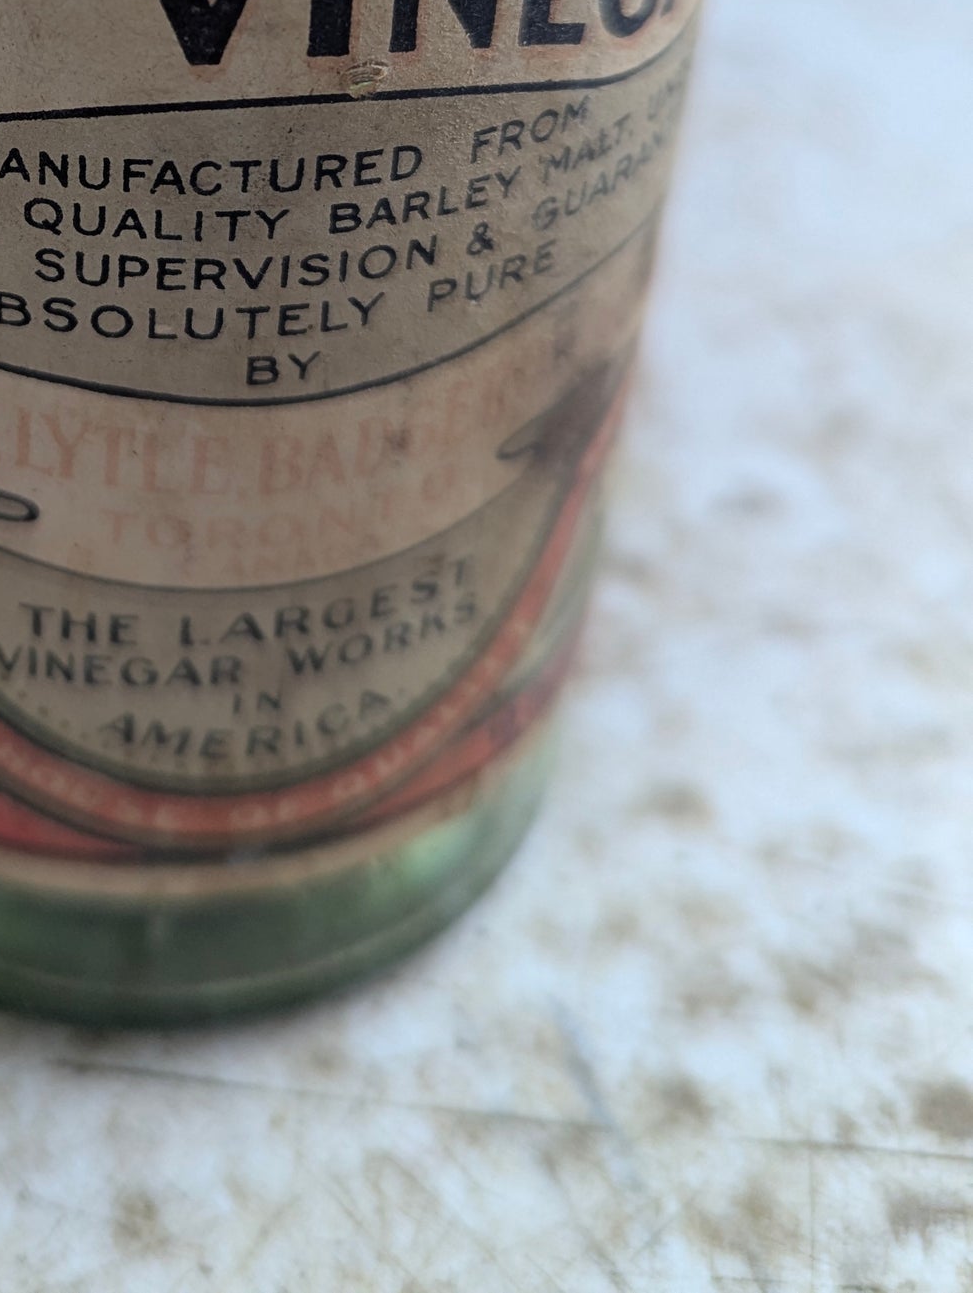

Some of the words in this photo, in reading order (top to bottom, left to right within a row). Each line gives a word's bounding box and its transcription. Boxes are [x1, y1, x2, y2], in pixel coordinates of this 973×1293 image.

[471, 96, 591, 164] FROM
[23, 197, 290, 242] QUALITY
[329, 165, 522, 234] BARLEY
[34, 235, 437, 291] SUPERVISION
[467, 222, 495, 256] &
[427, 240, 559, 312] PURE
[246, 352, 321, 386] BY
[19, 603, 138, 646] THE
[180, 555, 473, 646] LARGEST
[289, 598, 477, 676] WORKS
[100, 688, 391, 760] AMERICA
[233, 690, 281, 716] IN
